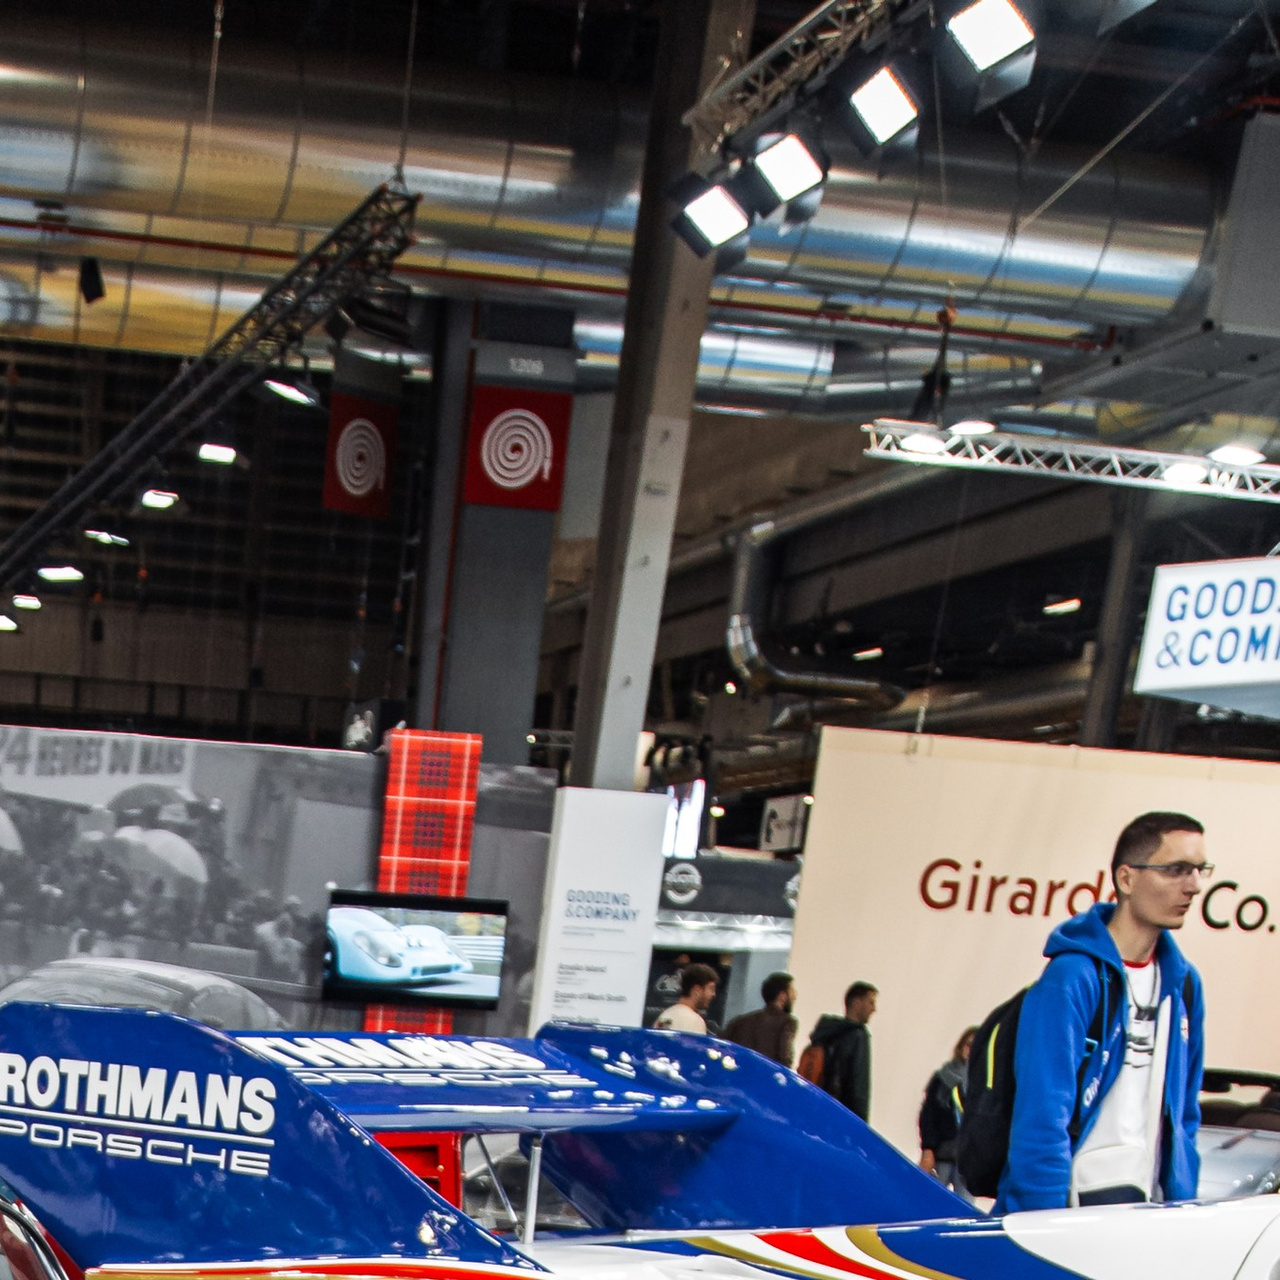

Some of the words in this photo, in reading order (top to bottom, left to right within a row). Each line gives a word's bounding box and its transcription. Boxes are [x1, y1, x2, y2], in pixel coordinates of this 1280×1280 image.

[1166, 576, 1280, 622] GOOD
[1156, 624, 1280, 669] &COM
[919, 857, 1118, 918] Girard
[1201, 880, 1276, 933] Co.
